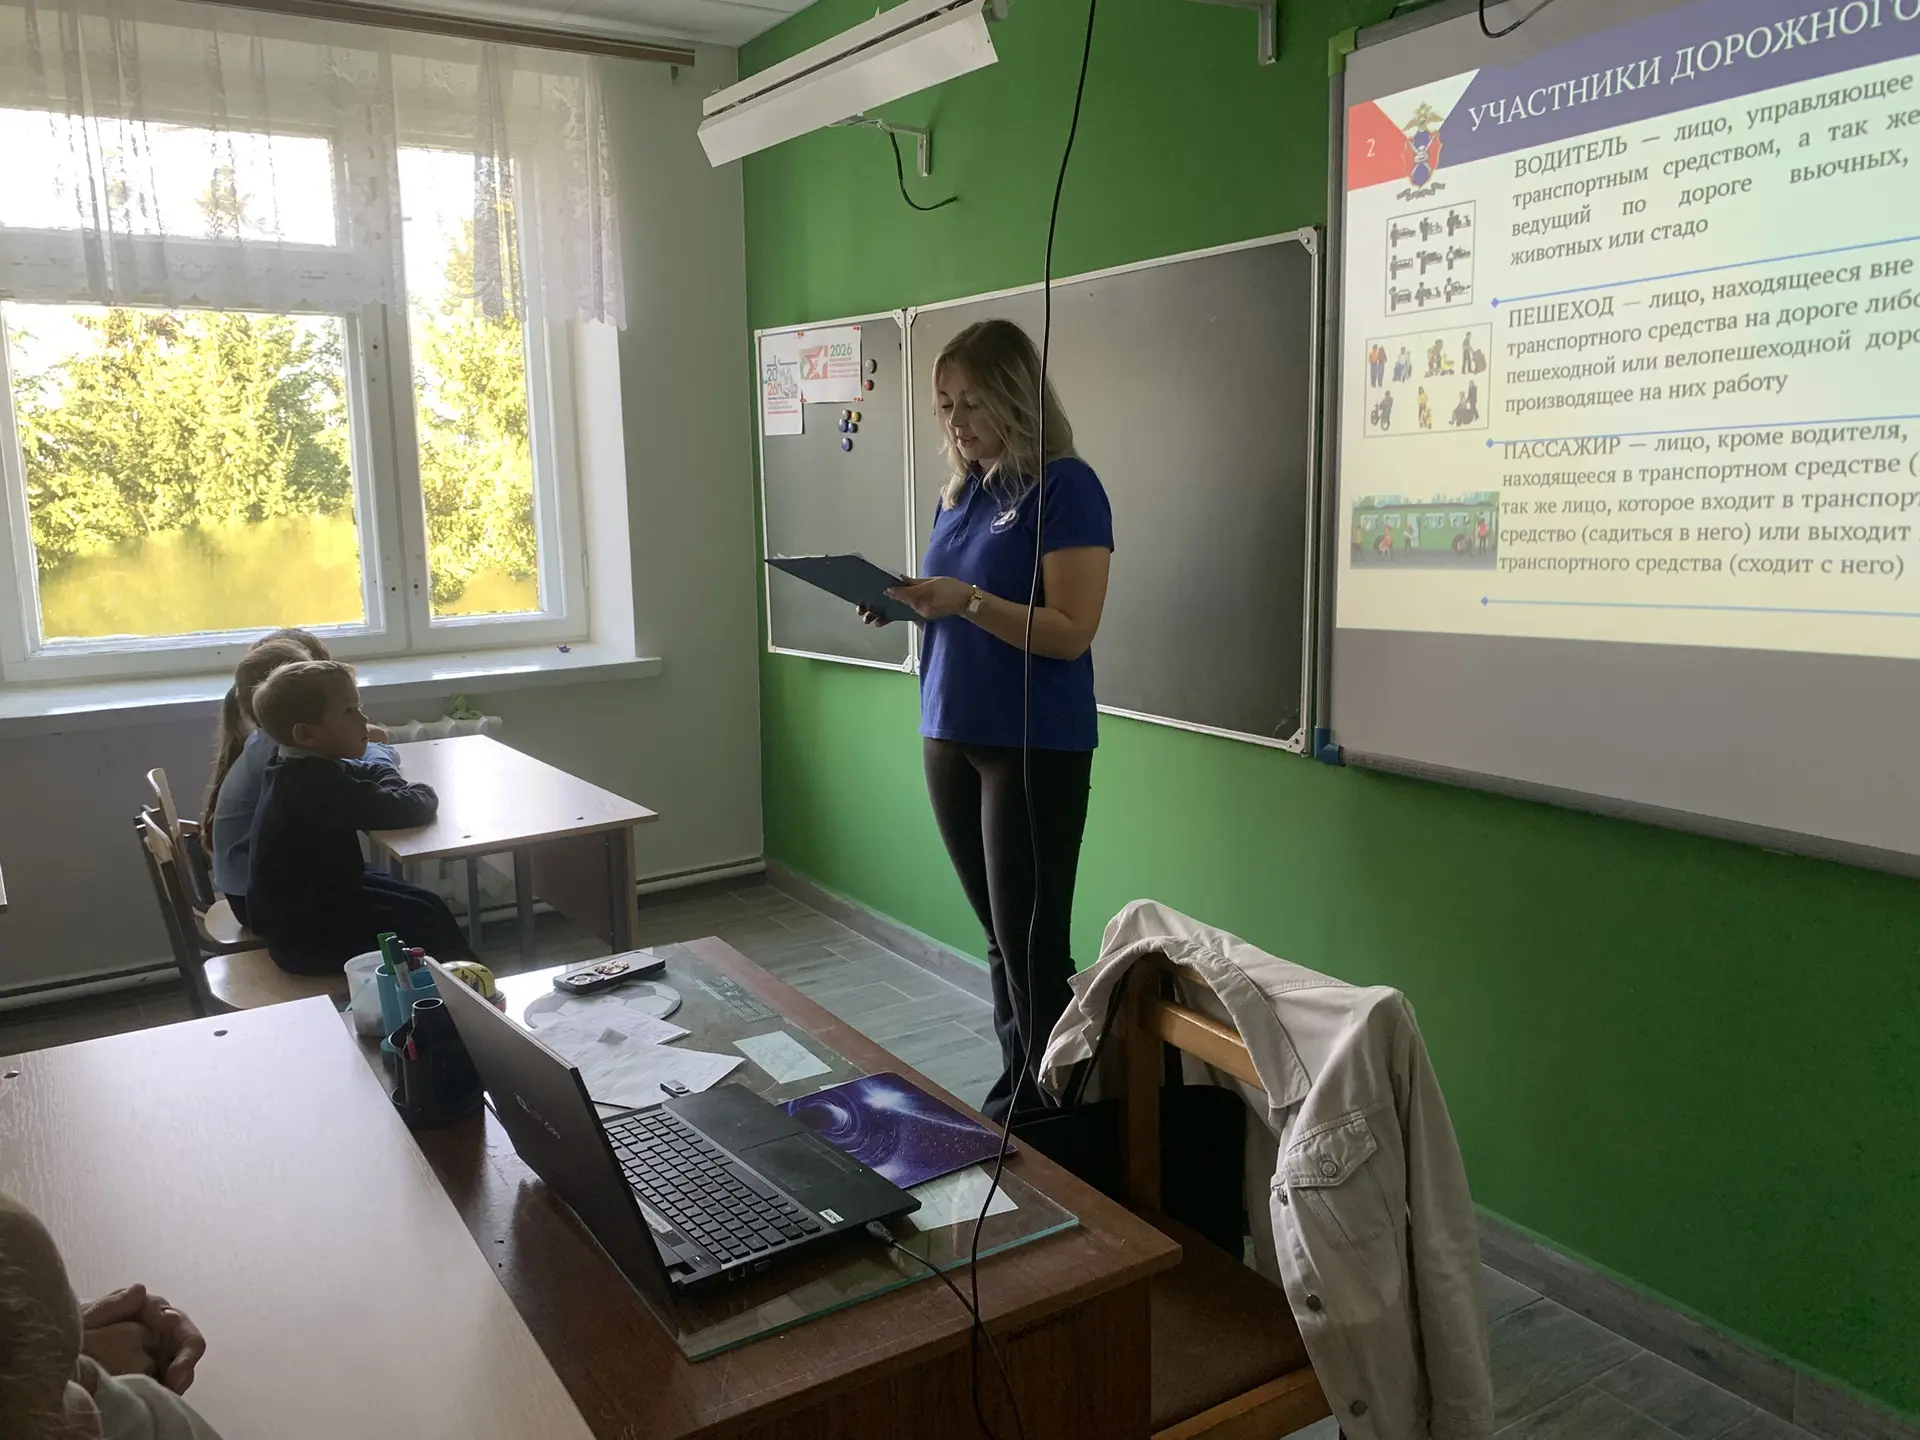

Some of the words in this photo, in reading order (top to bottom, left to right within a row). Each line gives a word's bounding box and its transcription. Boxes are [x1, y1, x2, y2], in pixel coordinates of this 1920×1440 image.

[1468, 55, 1662, 131] УЧАСТНИКИ
[1366, 138, 1376, 158] 2
[1514, 135, 1628, 178] ВОДИТЕЛЬ
[1674, 116, 1733, 142] лицо,
[1746, 74, 1914, 130] управляющее
[1512, 166, 1649, 210] транспортным
[1663, 138, 1781, 179] средством,
[1798, 130, 1811, 148] а
[1828, 119, 1869, 142] так
[1886, 108, 1920, 131] же
[1511, 204, 1592, 237] ведущий
[1622, 198, 1647, 216] по
[1678, 177, 1753, 208] дороге
[1789, 147, 1909, 184] вьючных,
[1510, 236, 1603, 266] животных
[1608, 229, 1645, 250] или
[1650, 218, 1709, 242] стадо
[1508, 296, 1615, 328] ПЕШЕХОД
[1648, 288, 1705, 309] лицо,
[1712, 264, 1863, 301] находящееся
[1869, 258, 1914, 280] вне
[830, 343, 853, 357] 2026
[1506, 326, 1642, 359] транспортного
[1648, 314, 1738, 343] средства
[1745, 311, 1771, 328] на
[1776, 299, 1858, 328] дороге
[1506, 354, 1616, 384] пешеходной
[1621, 356, 1658, 374] или
[1664, 328, 1853, 369] велопешеходной
[1505, 387, 1634, 416] производящее
[1639, 385, 1663, 402] на
[1668, 380, 1706, 400] них
[1712, 373, 1789, 400] работу
[1504, 436, 1621, 460] ПАССАЖИР
[1654, 435, 1711, 453] лицо,
[1717, 430, 1784, 452] кроме
[1790, 424, 1909, 446] водителя,
[1502, 470, 1617, 488] находящееся
[1622, 470, 1633, 483] в
[1638, 461, 1788, 486] транспортном
[1795, 456, 1901, 481] средстве
[1501, 501, 1529, 515] так
[1534, 500, 1557, 514] же
[1561, 499, 1612, 516] лицо,
[1617, 497, 1695, 516] которое
[1701, 494, 1775, 513] входит
[1782, 494, 1794, 509] в
[1500, 527, 1577, 546] средство
[1581, 525, 1673, 546] (садиться
[1679, 528, 1690, 541] в
[1696, 522, 1752, 546] него)
[1758, 525, 1800, 541] или
[1807, 524, 1912, 544] выходит
[1499, 556, 1631, 575] транспортного
[1635, 557, 1722, 575] средства
[1729, 553, 1814, 577] (сходит
[1820, 559, 1833, 573] с
[1840, 554, 1905, 580] него)
